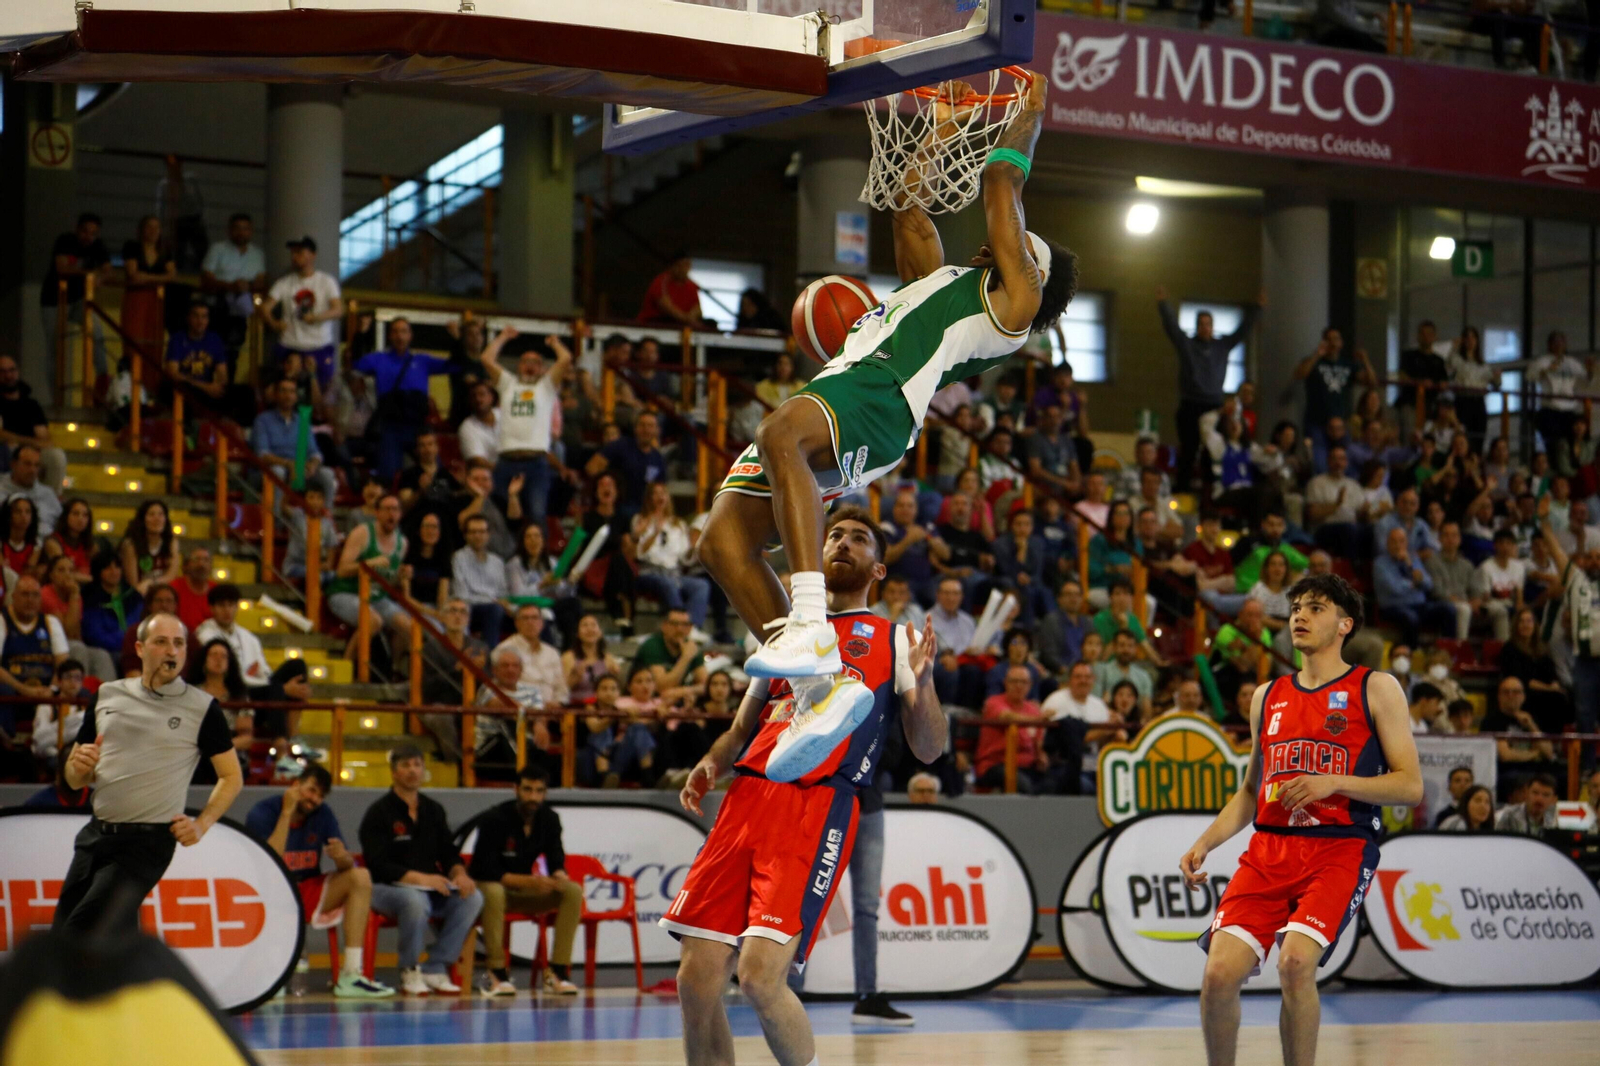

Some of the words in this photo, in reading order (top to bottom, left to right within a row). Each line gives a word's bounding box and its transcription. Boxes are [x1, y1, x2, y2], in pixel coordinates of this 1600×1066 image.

[1135, 35, 1395, 127] IMDECO
[1052, 103, 1126, 130] Instituto
[1128, 111, 1213, 143] Municipal
[1215, 122, 1239, 143] de
[1241, 124, 1319, 152] Deportes
[1320, 132, 1392, 160] Córdoba
[1464, 245, 1482, 273] D
[1267, 712, 1282, 736] 6
[1111, 759, 1248, 814] CORDOB
[670, 890, 690, 916] 11
[1460, 886, 1584, 917] Diputación
[761, 913, 783, 925] vive
[1306, 914, 1327, 929] vive
[1470, 917, 1498, 940] de
[1503, 916, 1594, 940] Córdoba
